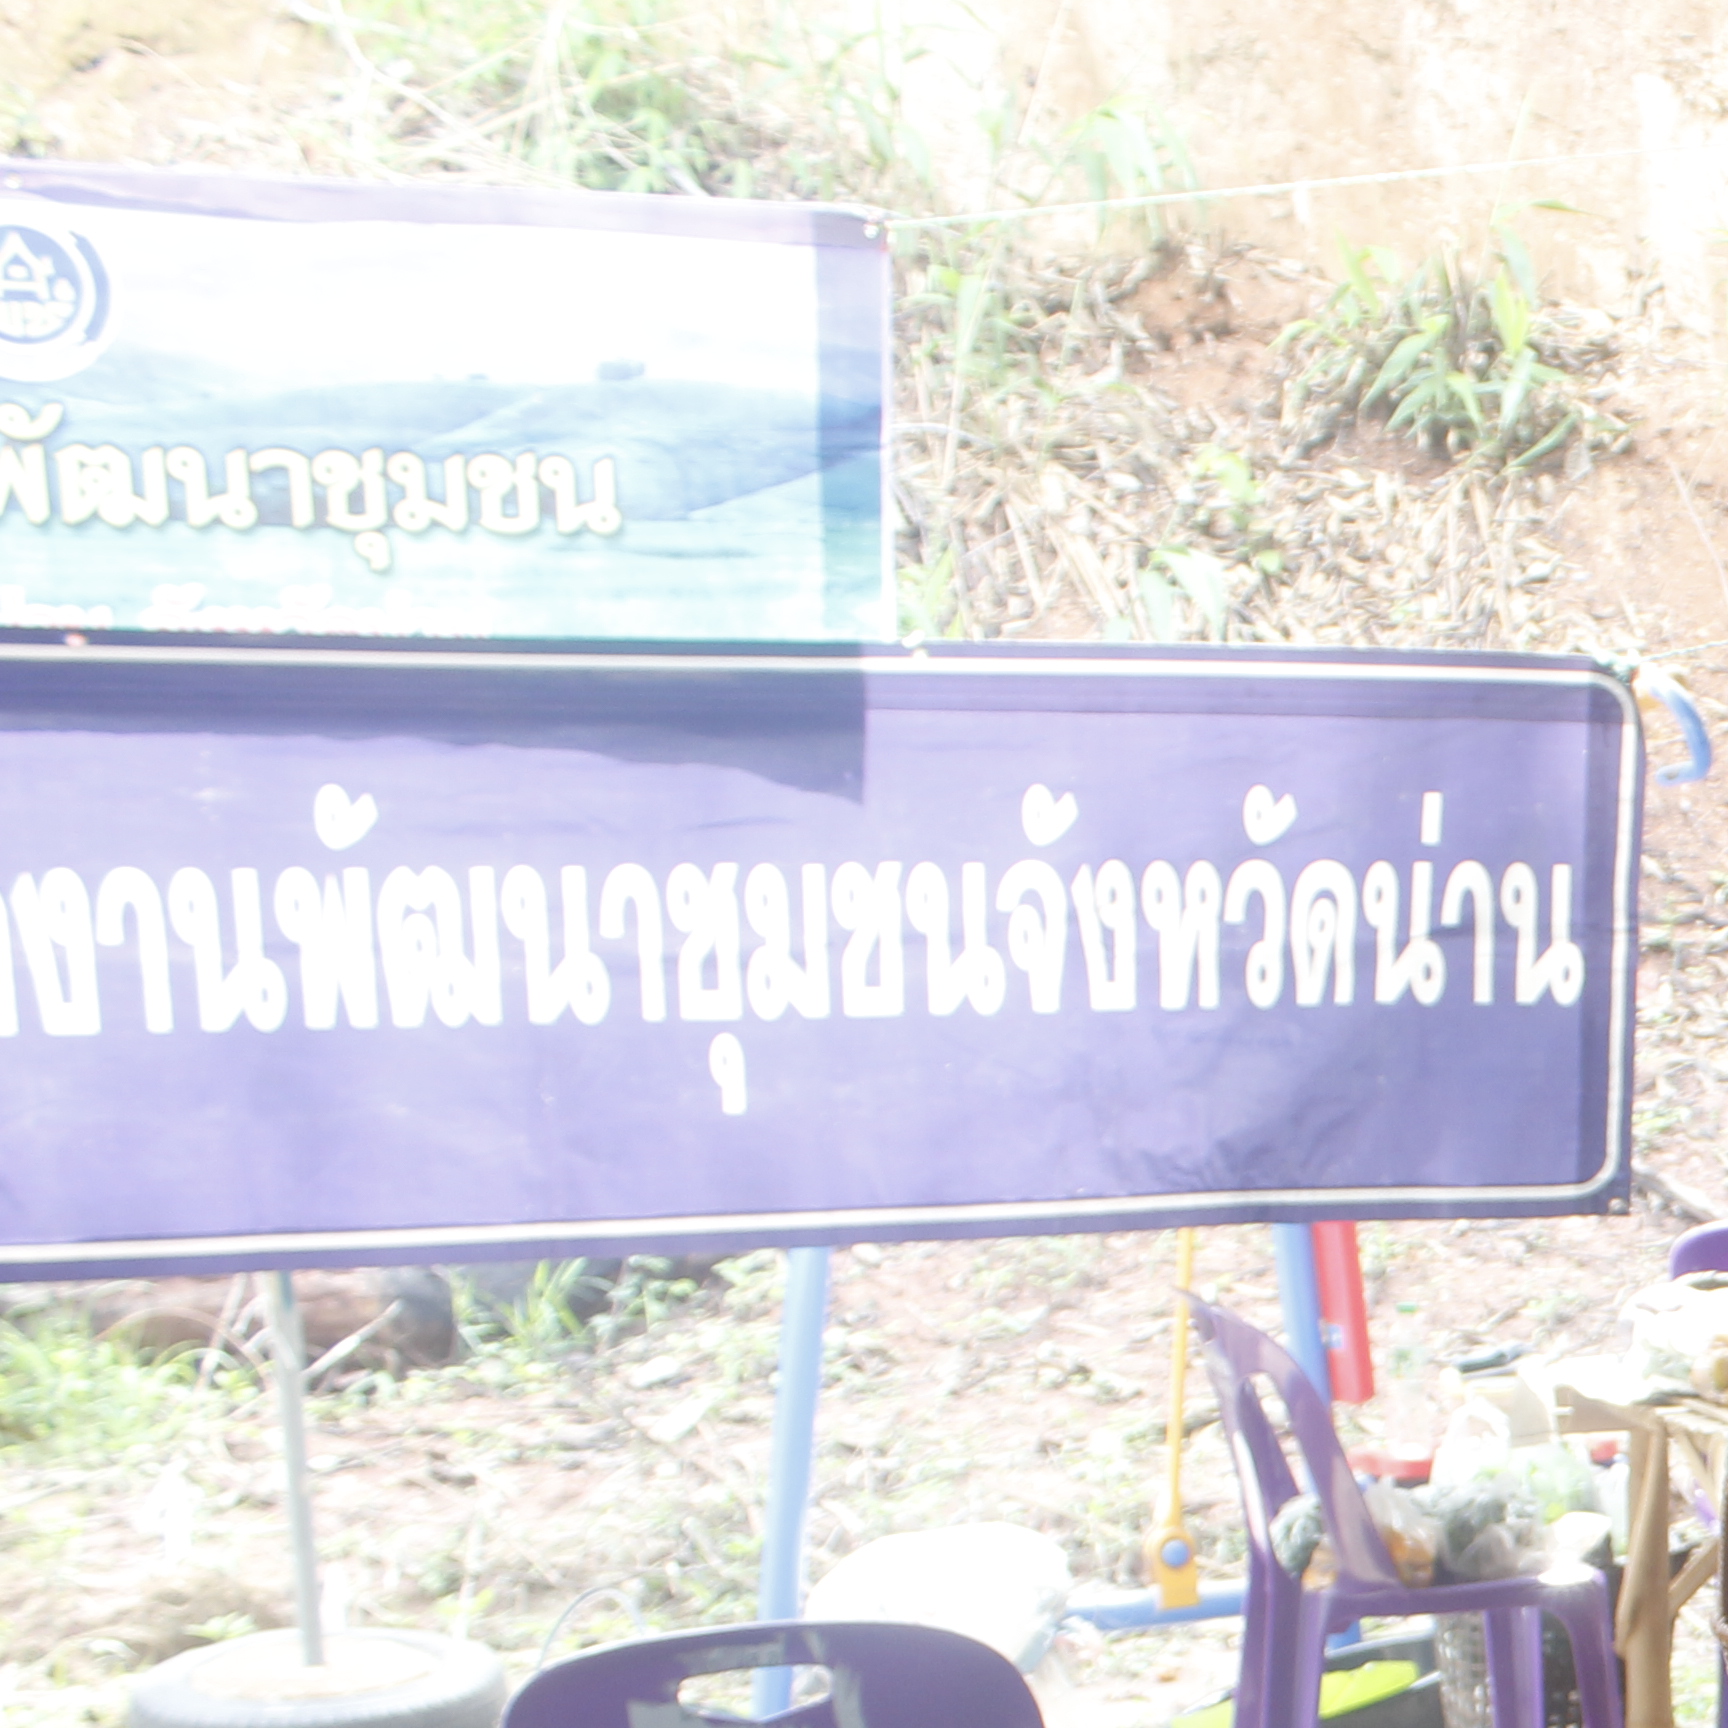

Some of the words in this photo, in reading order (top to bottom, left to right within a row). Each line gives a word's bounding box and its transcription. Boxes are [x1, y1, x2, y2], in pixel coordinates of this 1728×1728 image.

[0, 783, 1584, 1115] งานพัฒนาชุมชนจังหวัดน่าน
